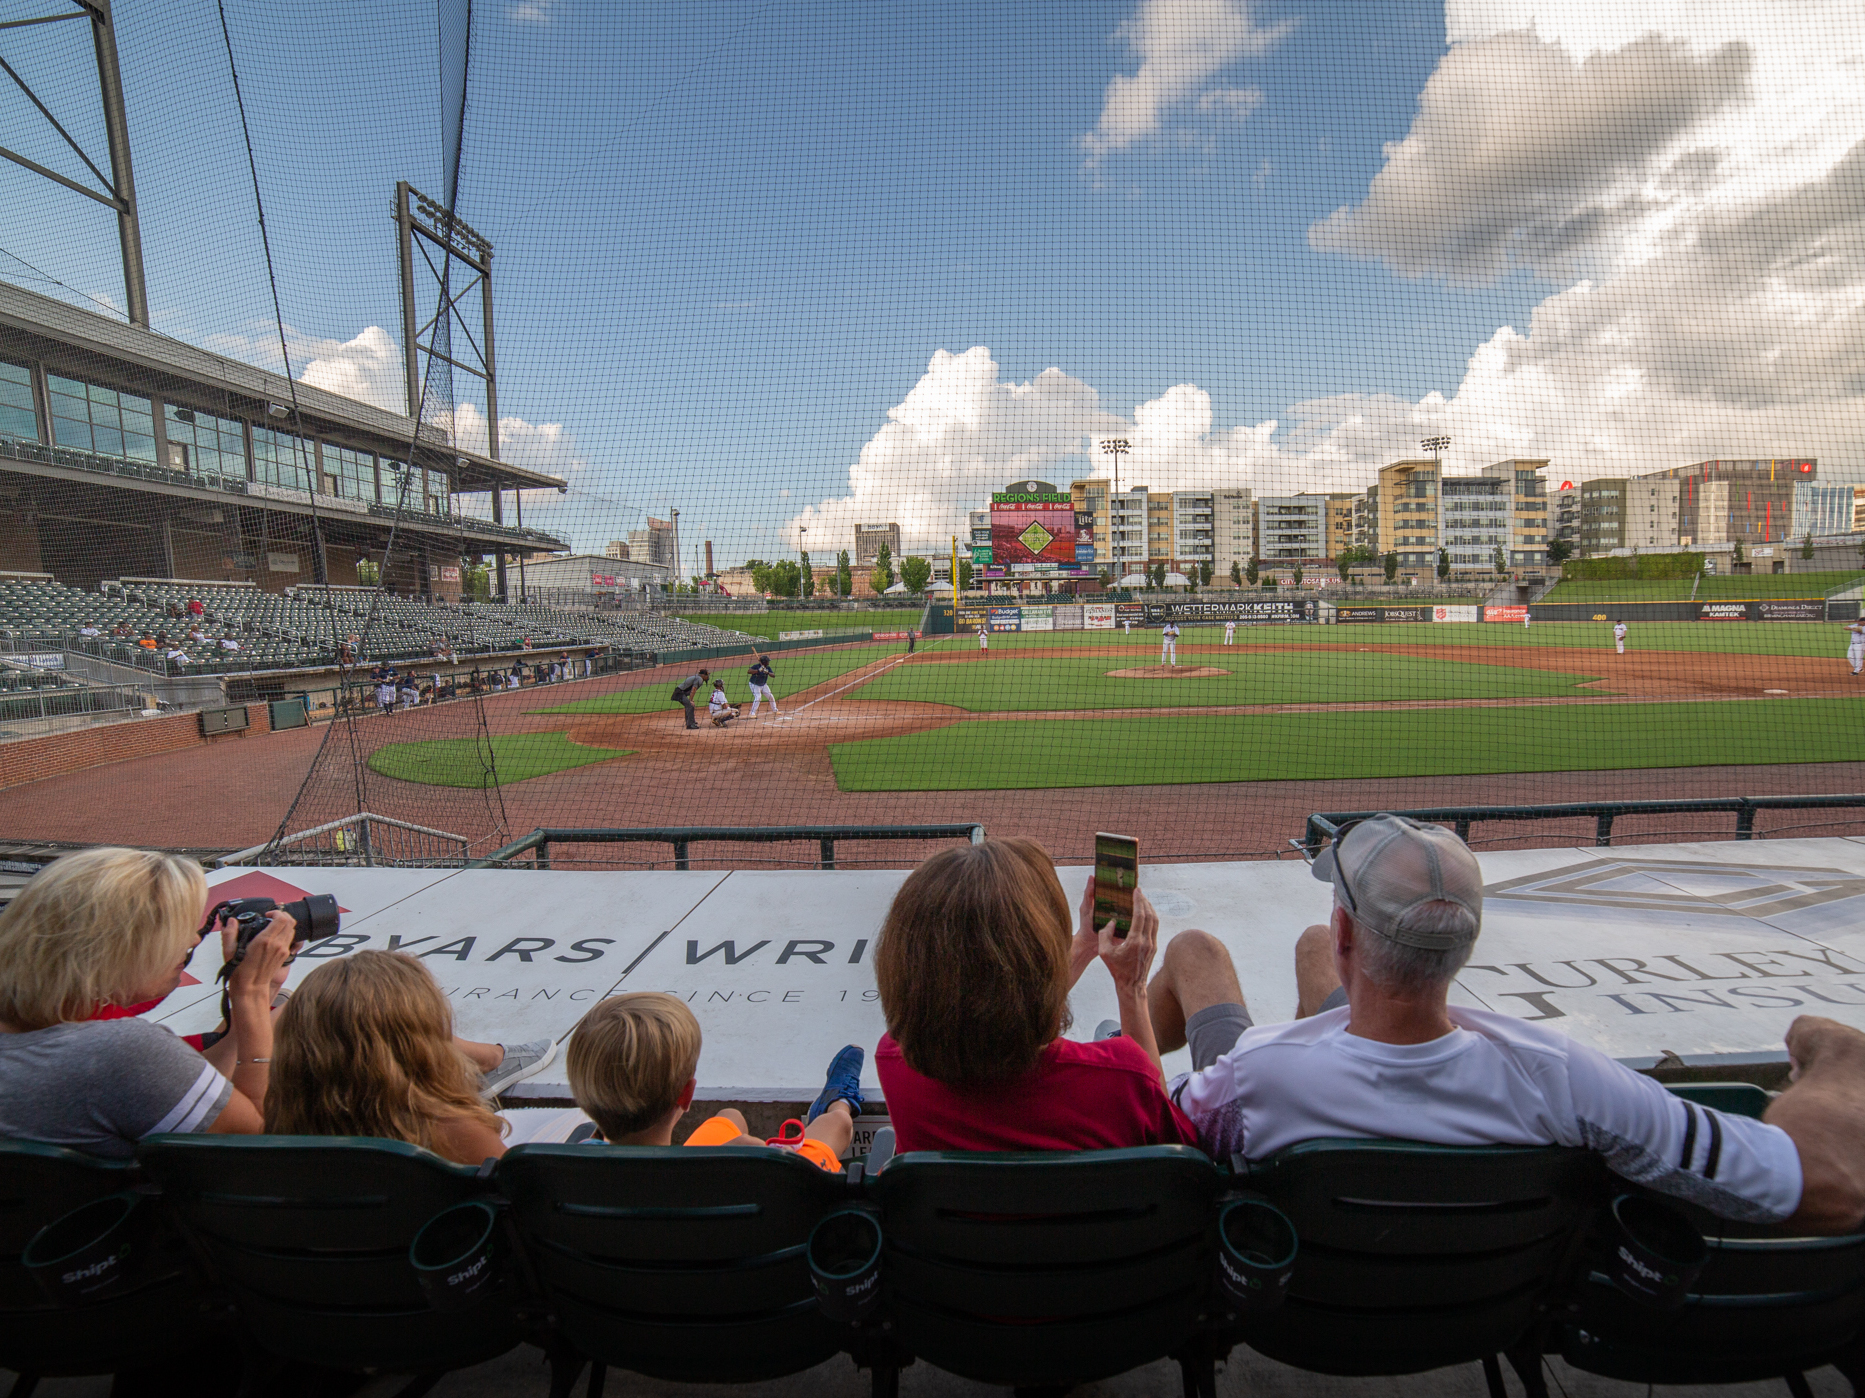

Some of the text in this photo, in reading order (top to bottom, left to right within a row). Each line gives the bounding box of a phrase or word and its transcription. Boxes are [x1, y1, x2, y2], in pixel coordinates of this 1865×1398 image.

[993, 493, 1071, 502] REGIONS FIELD
[1078, 514, 1093, 525] Lite
[943, 609, 954, 617] 320
[1711, 604, 1746, 612] MAGNA
[1385, 610, 1416, 618] JOBSQUEST
[297, 933, 616, 964] BYARS
[62, 1255, 117, 1284] Shipt
[1618, 1246, 1662, 1282] Shipt
[446, 1255, 487, 1286] Shipt
